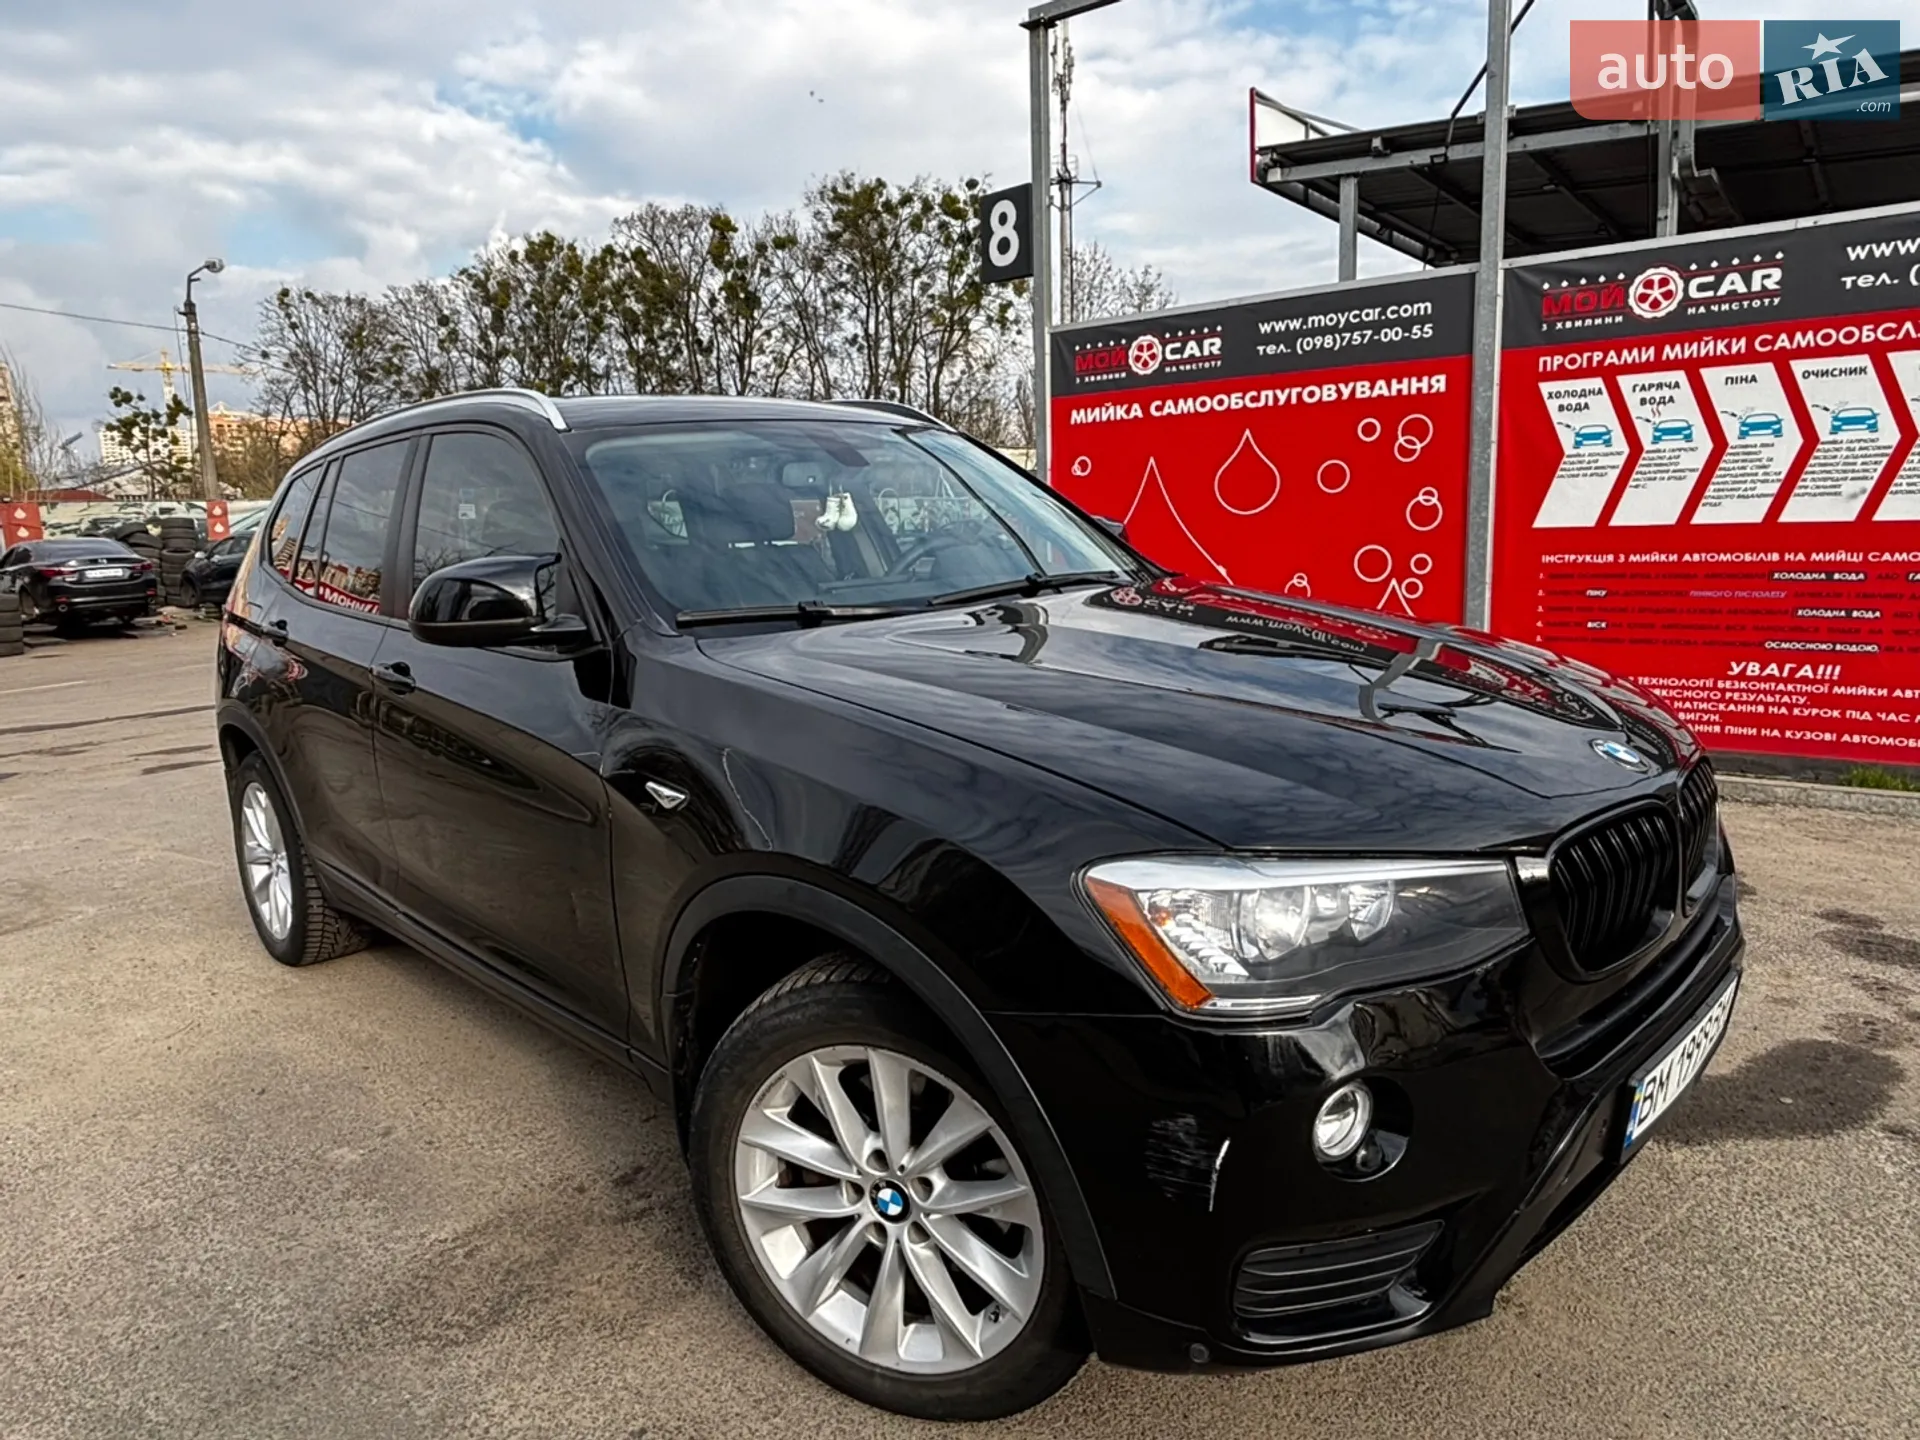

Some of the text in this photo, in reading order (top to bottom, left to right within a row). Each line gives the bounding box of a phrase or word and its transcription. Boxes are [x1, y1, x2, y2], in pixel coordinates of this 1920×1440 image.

[988, 199, 1020, 268] 8
[1688, 267, 1783, 299] CAR
[1840, 272, 1900, 290] тел.
[1258, 301, 1432, 334] www.moycar.com
[1165, 336, 1222, 361] CAR
[1256, 323, 1434, 356] тел. (098)757-00-55
[1538, 346, 1655, 373] ПРОГРАМИ
[1662, 336, 1746, 361] МИЙКИ
[1724, 373, 1758, 386] ПІНА
[1801, 365, 1868, 380] ОЧИСНИК
[1547, 386, 1604, 400] ХОЛОДНА
[1632, 380, 1681, 393] ГАРЯЧА
[1070, 374, 1447, 425] МИЙКА САМООБСЛУГОВУВАННЯ
[1557, 401, 1590, 413] ВОДА
[1639, 395, 1675, 407] ВОДА
[1542, 553, 1614, 564] ІНСТРУКЦІЯ
[1628, 551, 1678, 563] МИЙКИ
[1682, 551, 1780, 562] АВТОМОБІЛІВ
[1784, 552, 1806, 562] НА
[1810, 549, 1863, 563] МИЙЦІ
[1726, 661, 1841, 680] УВАГА!!!
[1637, 676, 1715, 688] ТЕХНОЛОГІЇ
[1717, 680, 1830, 694] БЕЗКОНТАКТНОЇ
[1832, 685, 1888, 698] МИЙКИ
[1673, 700, 1765, 714] НАТИСКАННЯ
[1768, 705, 1789, 716] НА
[1792, 706, 1841, 719] КУРОК
[1845, 709, 1873, 721] ПІД
[1876, 711, 1911, 723] ЧАС
[1725, 725, 1757, 736] ПІНИ
[1760, 727, 1781, 738] НА
[1785, 729, 1837, 741] КУЗОВІ
